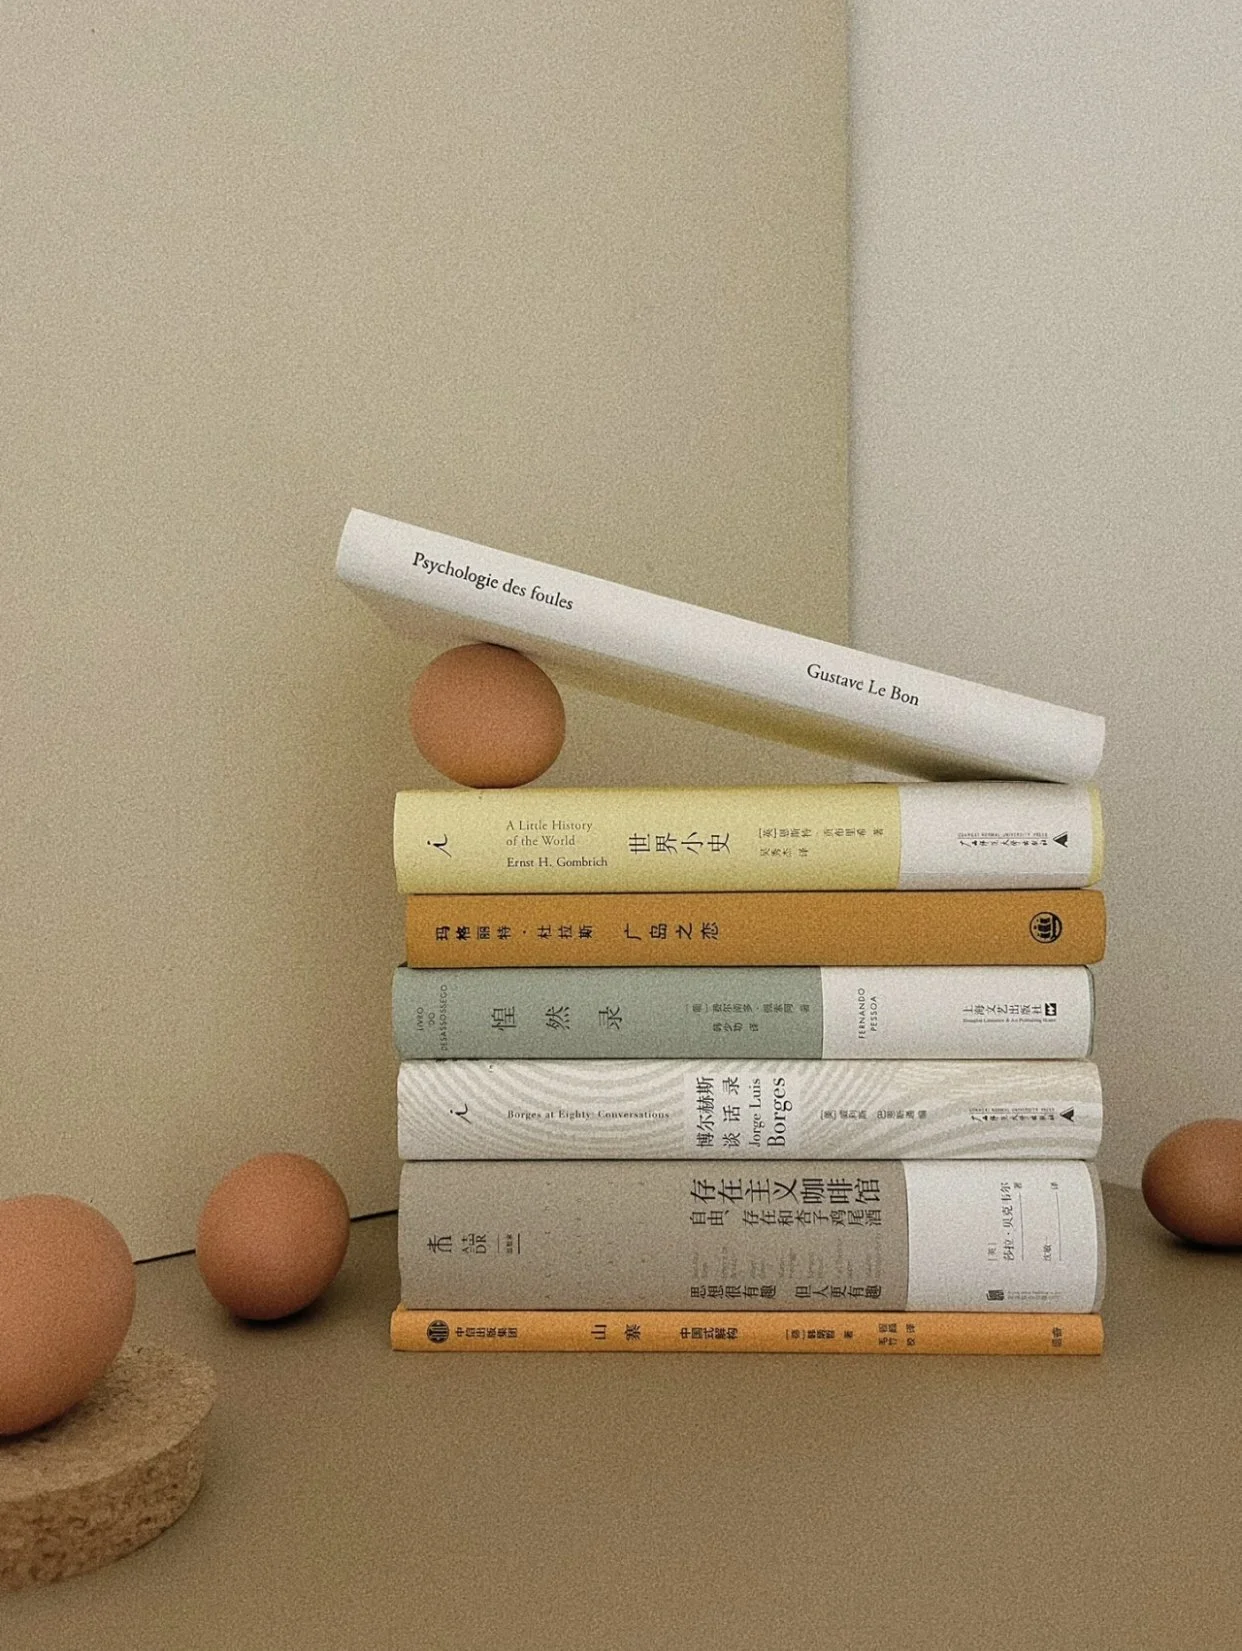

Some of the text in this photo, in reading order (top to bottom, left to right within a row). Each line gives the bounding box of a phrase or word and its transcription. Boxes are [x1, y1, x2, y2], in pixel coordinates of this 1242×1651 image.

[412, 552, 574, 610] Psychologie des foules
[806, 663, 919, 706] Gustave Le Bon
[506, 820, 593, 833] A Little History
[506, 834, 576, 846] of the World
[628, 831, 731, 855] 世界小史
[507, 856, 608, 868] Ernst H. Gombrich
[624, 922, 719, 940] 广岛之恋
[491, 1006, 623, 1031] 惶然录
[857, 987, 867, 1039] FERNANDO
[870, 996, 878, 1031] PESSOA
[507, 1110, 542, 1120] Borges
[545, 1110, 554, 1119] at
[597, 1110, 670, 1119] Conversations
[696, 1077, 715, 1148] 博尔赫斯
[722, 1076, 741, 1148] 谈话录
[748, 1078, 765, 1147] Jorge Luis
[767, 1077, 793, 1147] Borges
[690, 1177, 881, 1205] 存在主义咖啡馆
[690, 1284, 882, 1299] 思想很有趣 但人更有趣
[455, 1326, 518, 1339] 中信出版集团
[591, 1323, 642, 1341] 山寨
